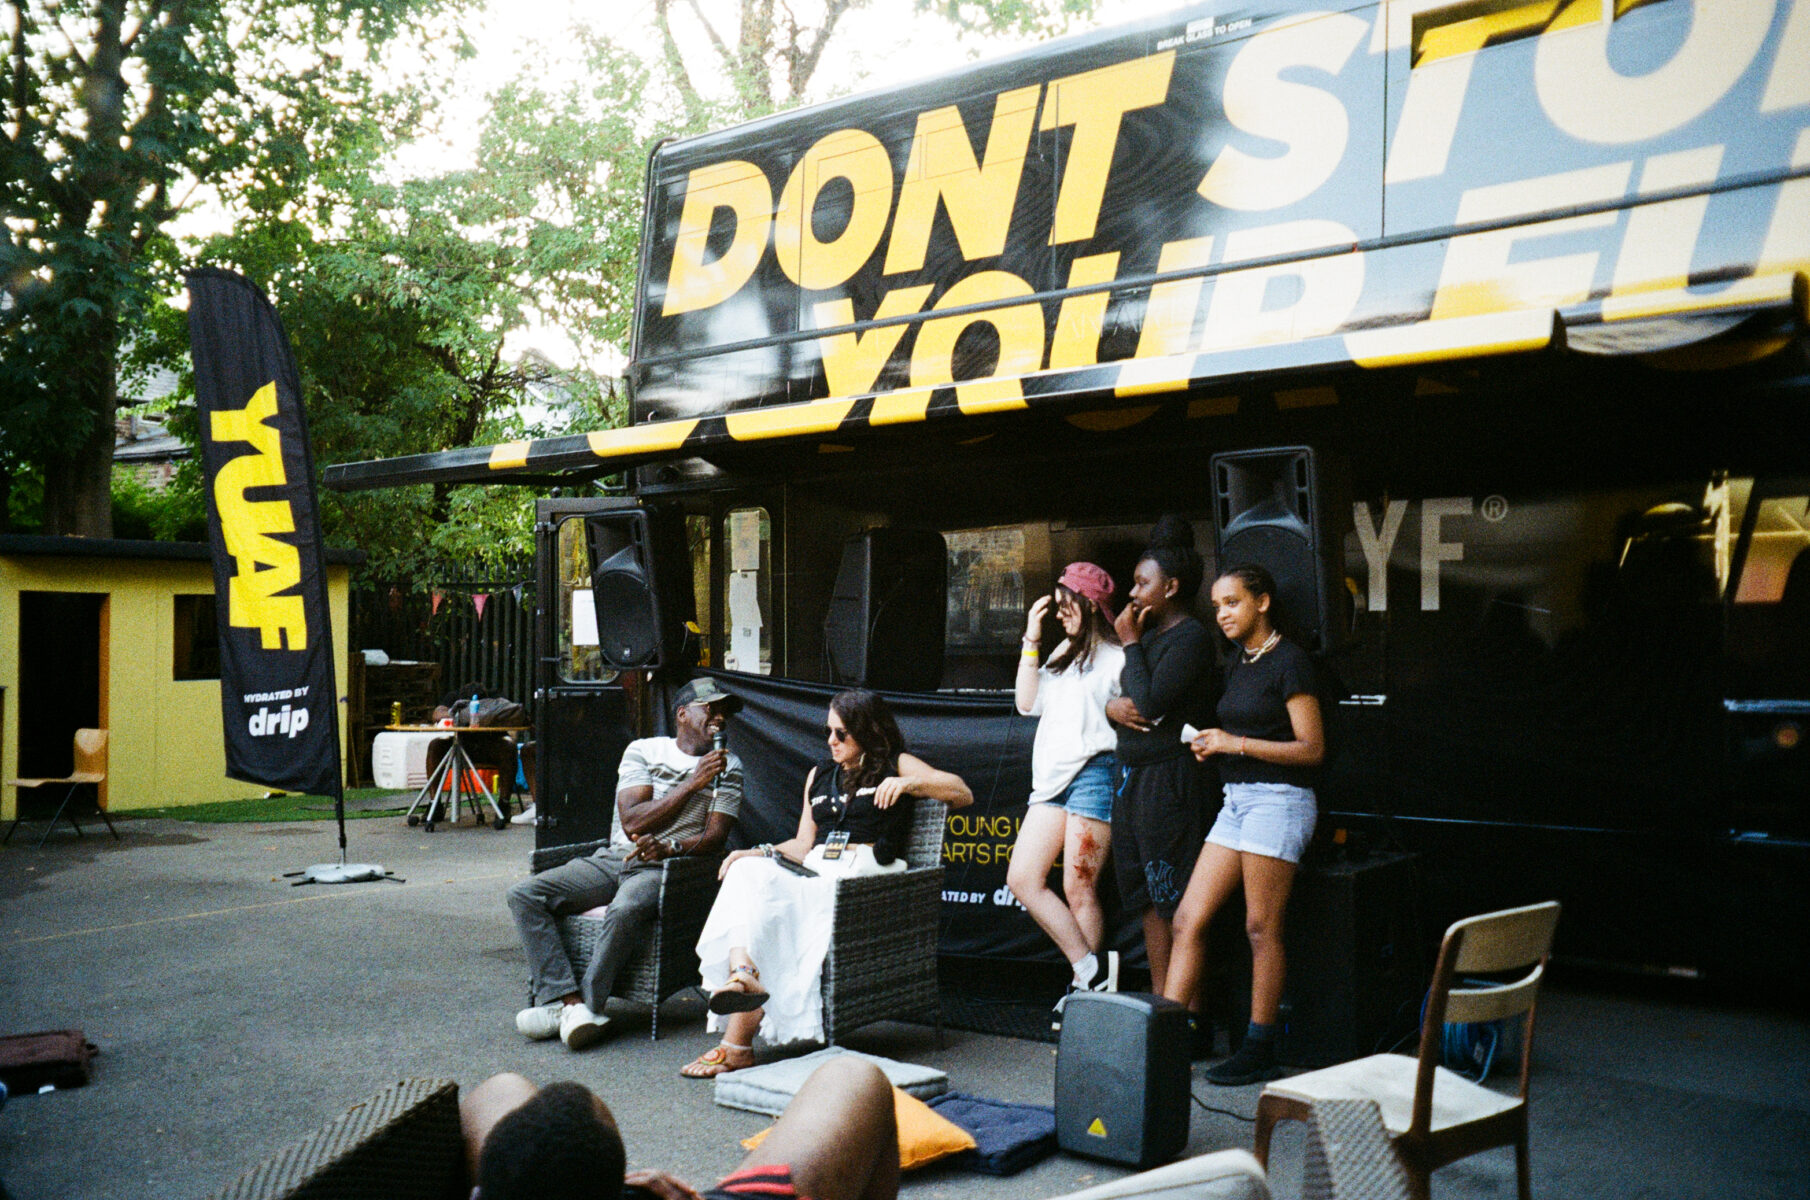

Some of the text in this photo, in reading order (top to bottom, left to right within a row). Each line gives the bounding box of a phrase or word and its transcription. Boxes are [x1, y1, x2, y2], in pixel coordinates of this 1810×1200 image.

[1215, 25, 1226, 35] TO
[1227, 18, 1252, 32] OPEN
[661, 50, 1176, 316] DONT
[210, 379, 308, 651] YUAF
[243, 685, 310, 703] HYDRATED BY
[248, 704, 309, 738] drip
[947, 815, 1011, 837] OUNG
[969, 892, 986, 904] BY
